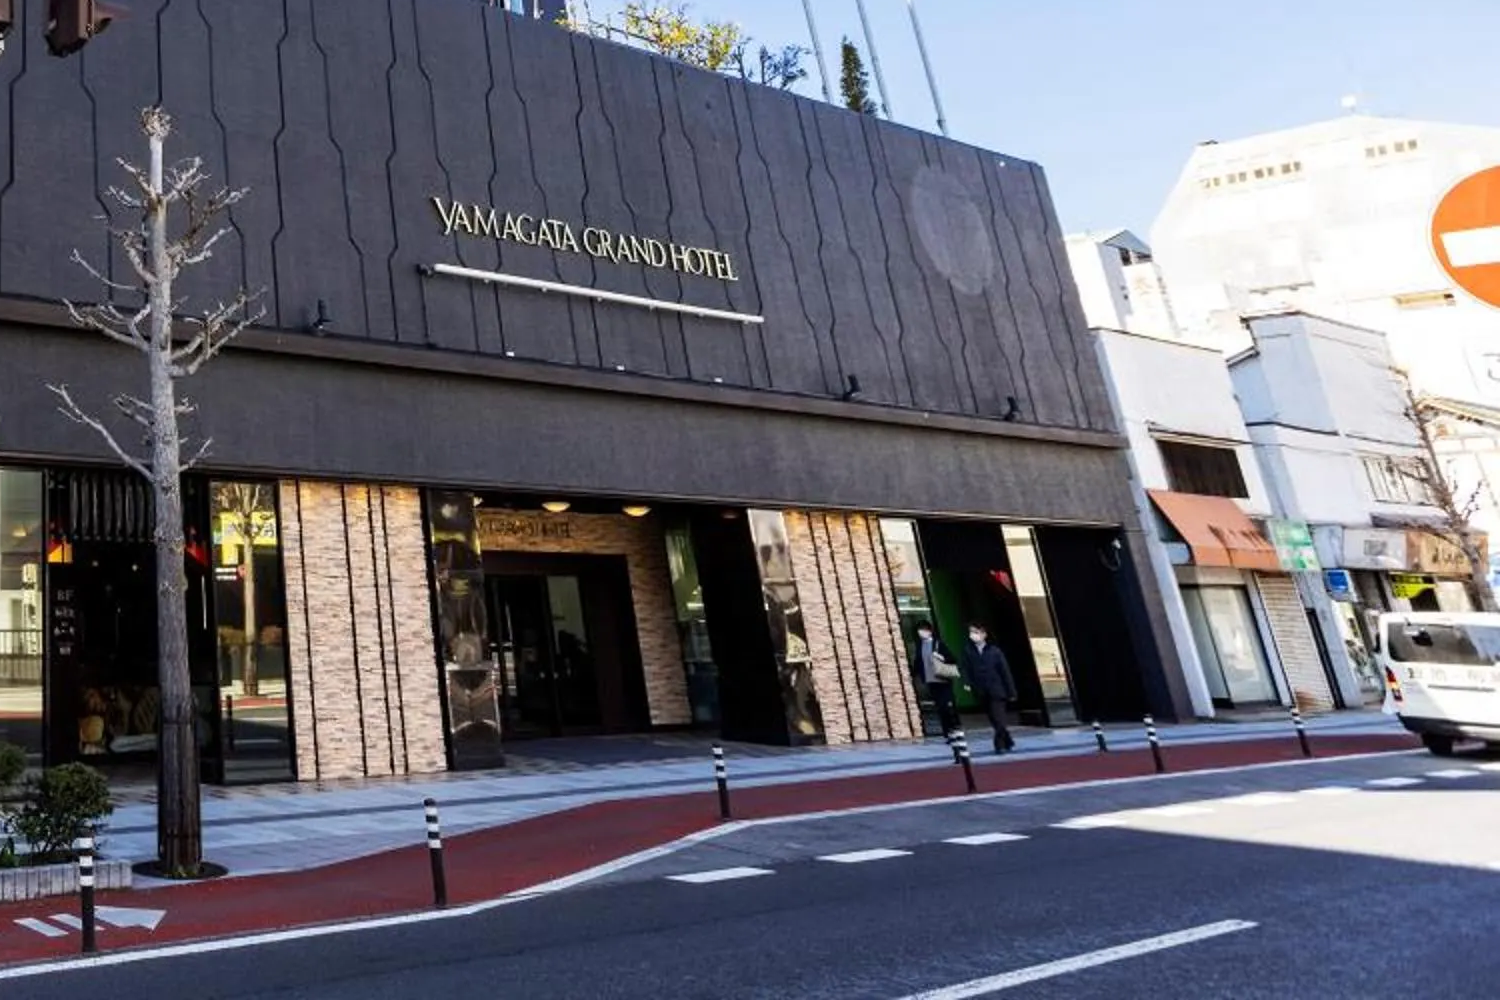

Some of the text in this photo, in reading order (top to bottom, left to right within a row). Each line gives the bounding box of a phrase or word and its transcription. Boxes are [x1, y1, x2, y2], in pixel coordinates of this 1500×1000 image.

[433, 196, 740, 282] YAMAGATA GRAND HOTEL
